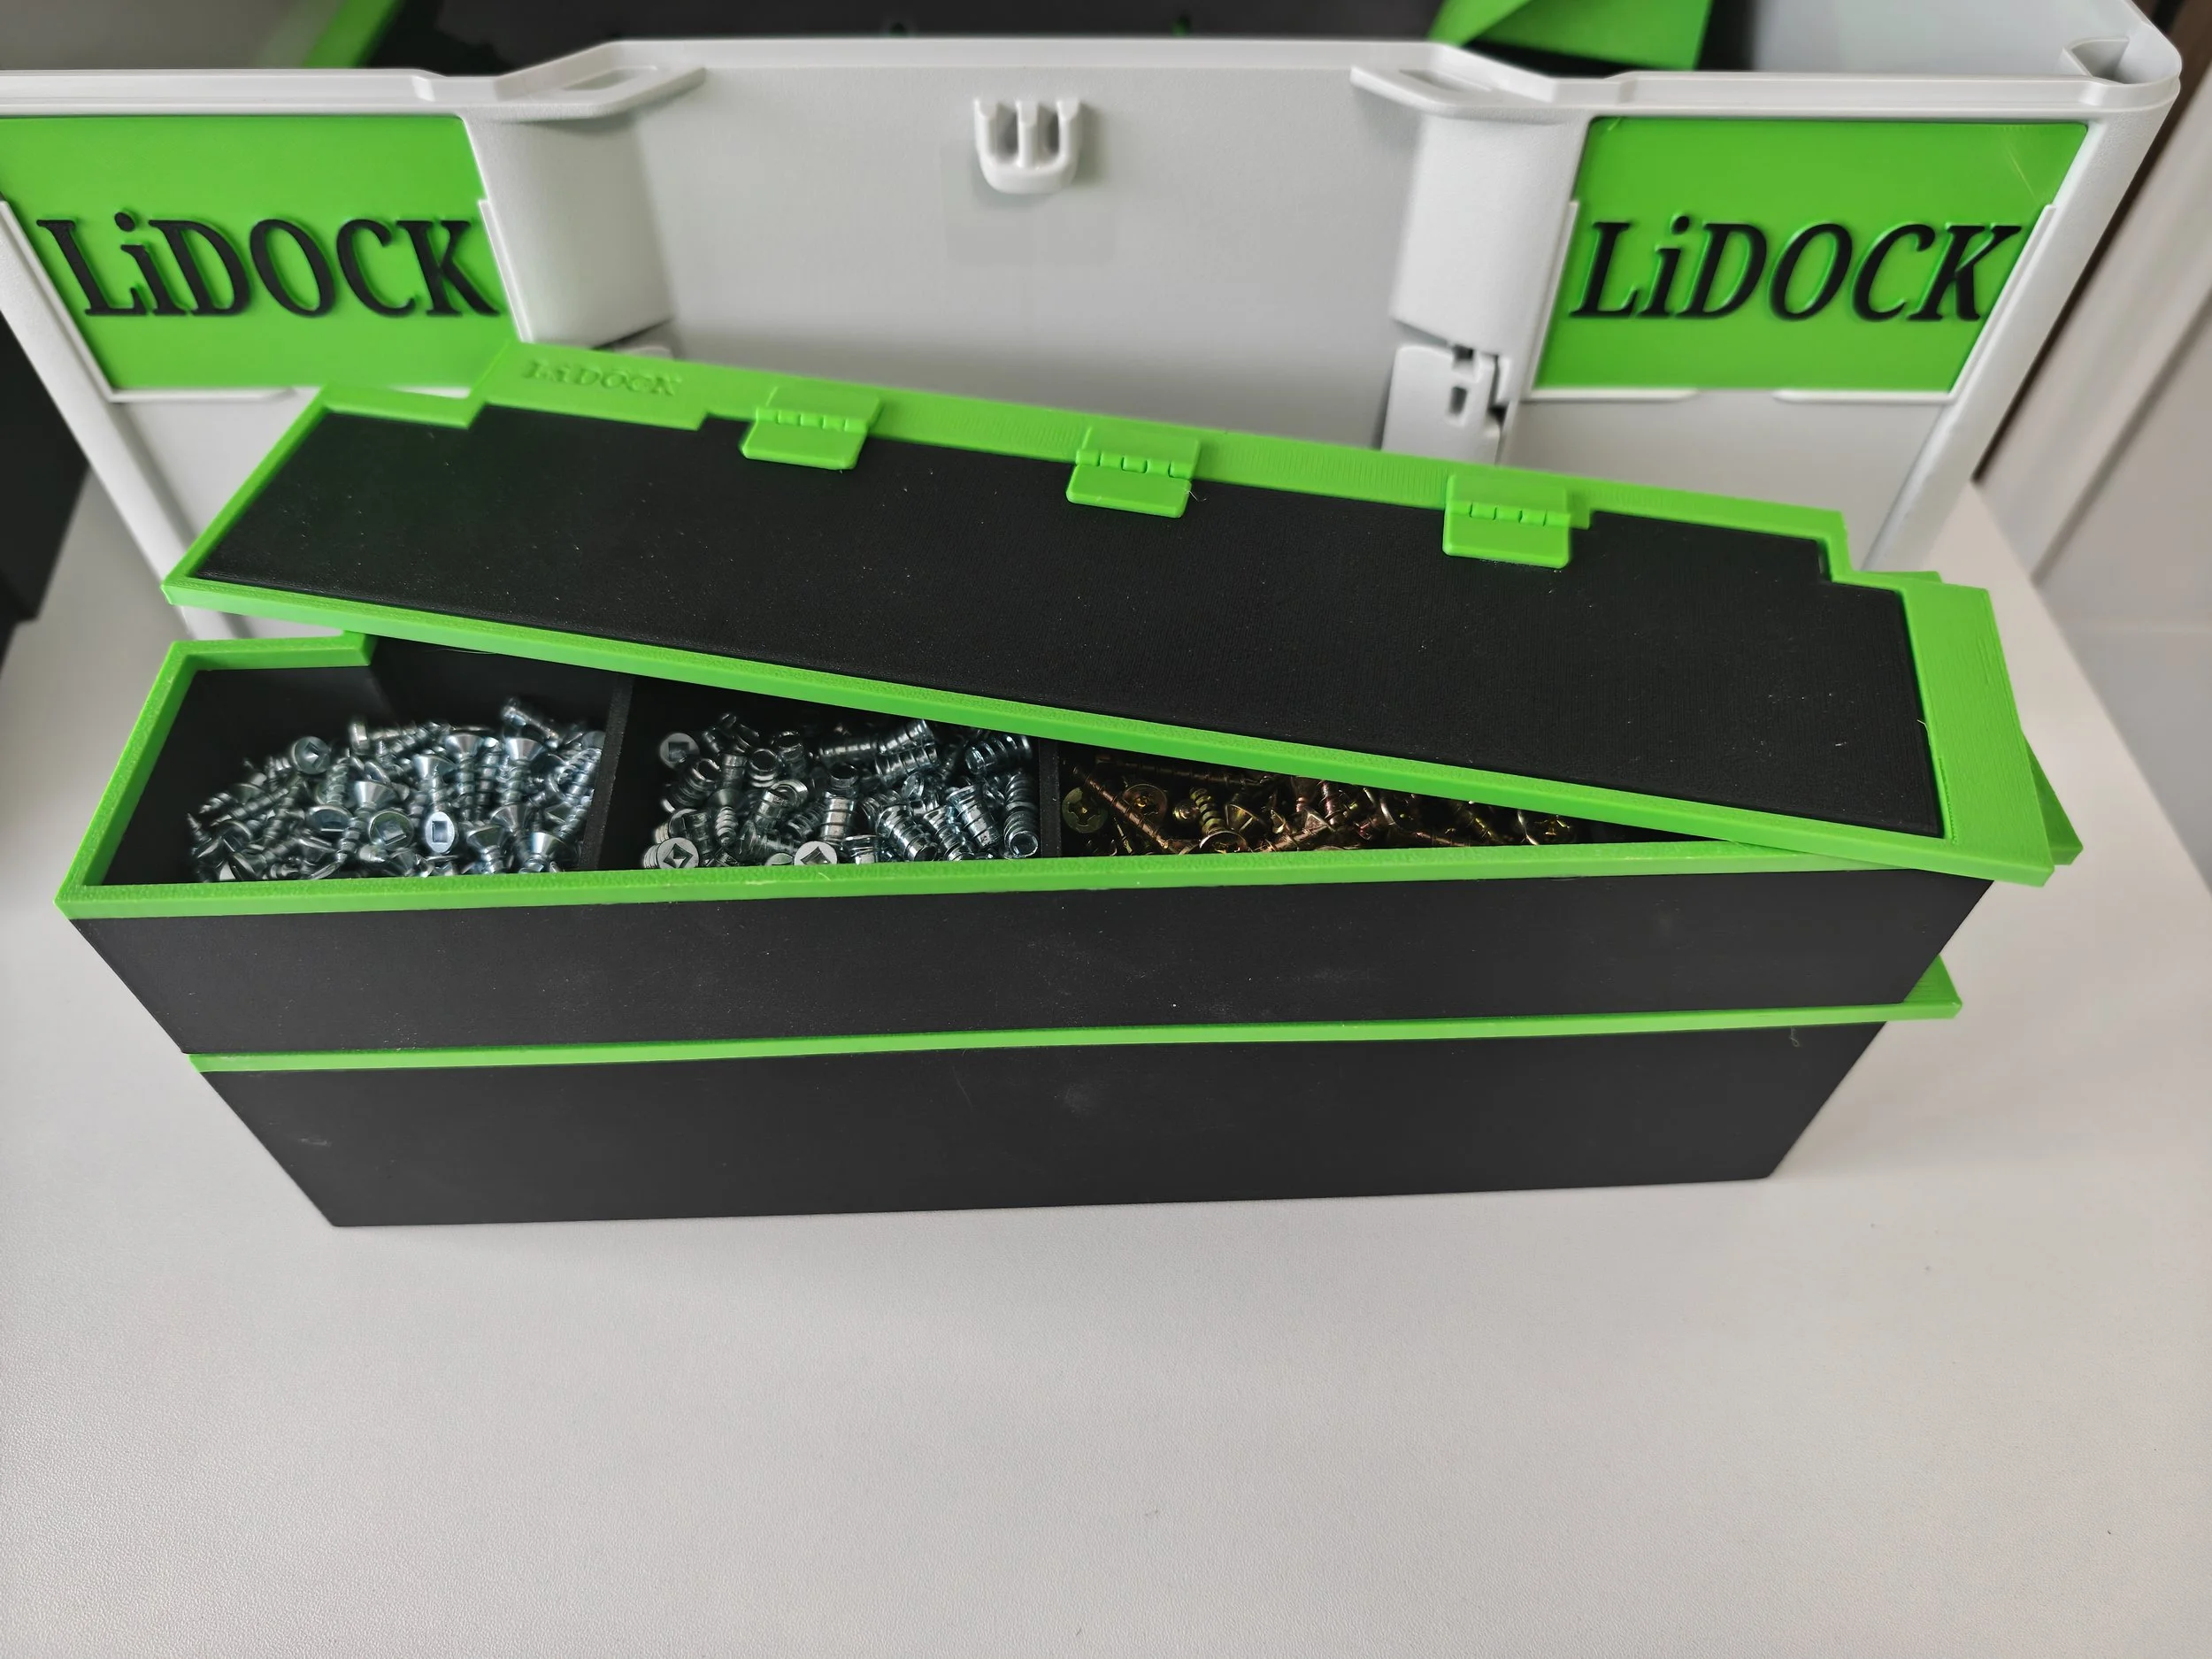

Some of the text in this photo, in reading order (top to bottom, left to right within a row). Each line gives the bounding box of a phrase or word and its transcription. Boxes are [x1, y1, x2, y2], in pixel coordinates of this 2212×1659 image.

[36, 211, 501, 319] LiDOCK
[1569, 215, 2022, 322] LiDOCK
[522, 358, 682, 396] LiDOCK
